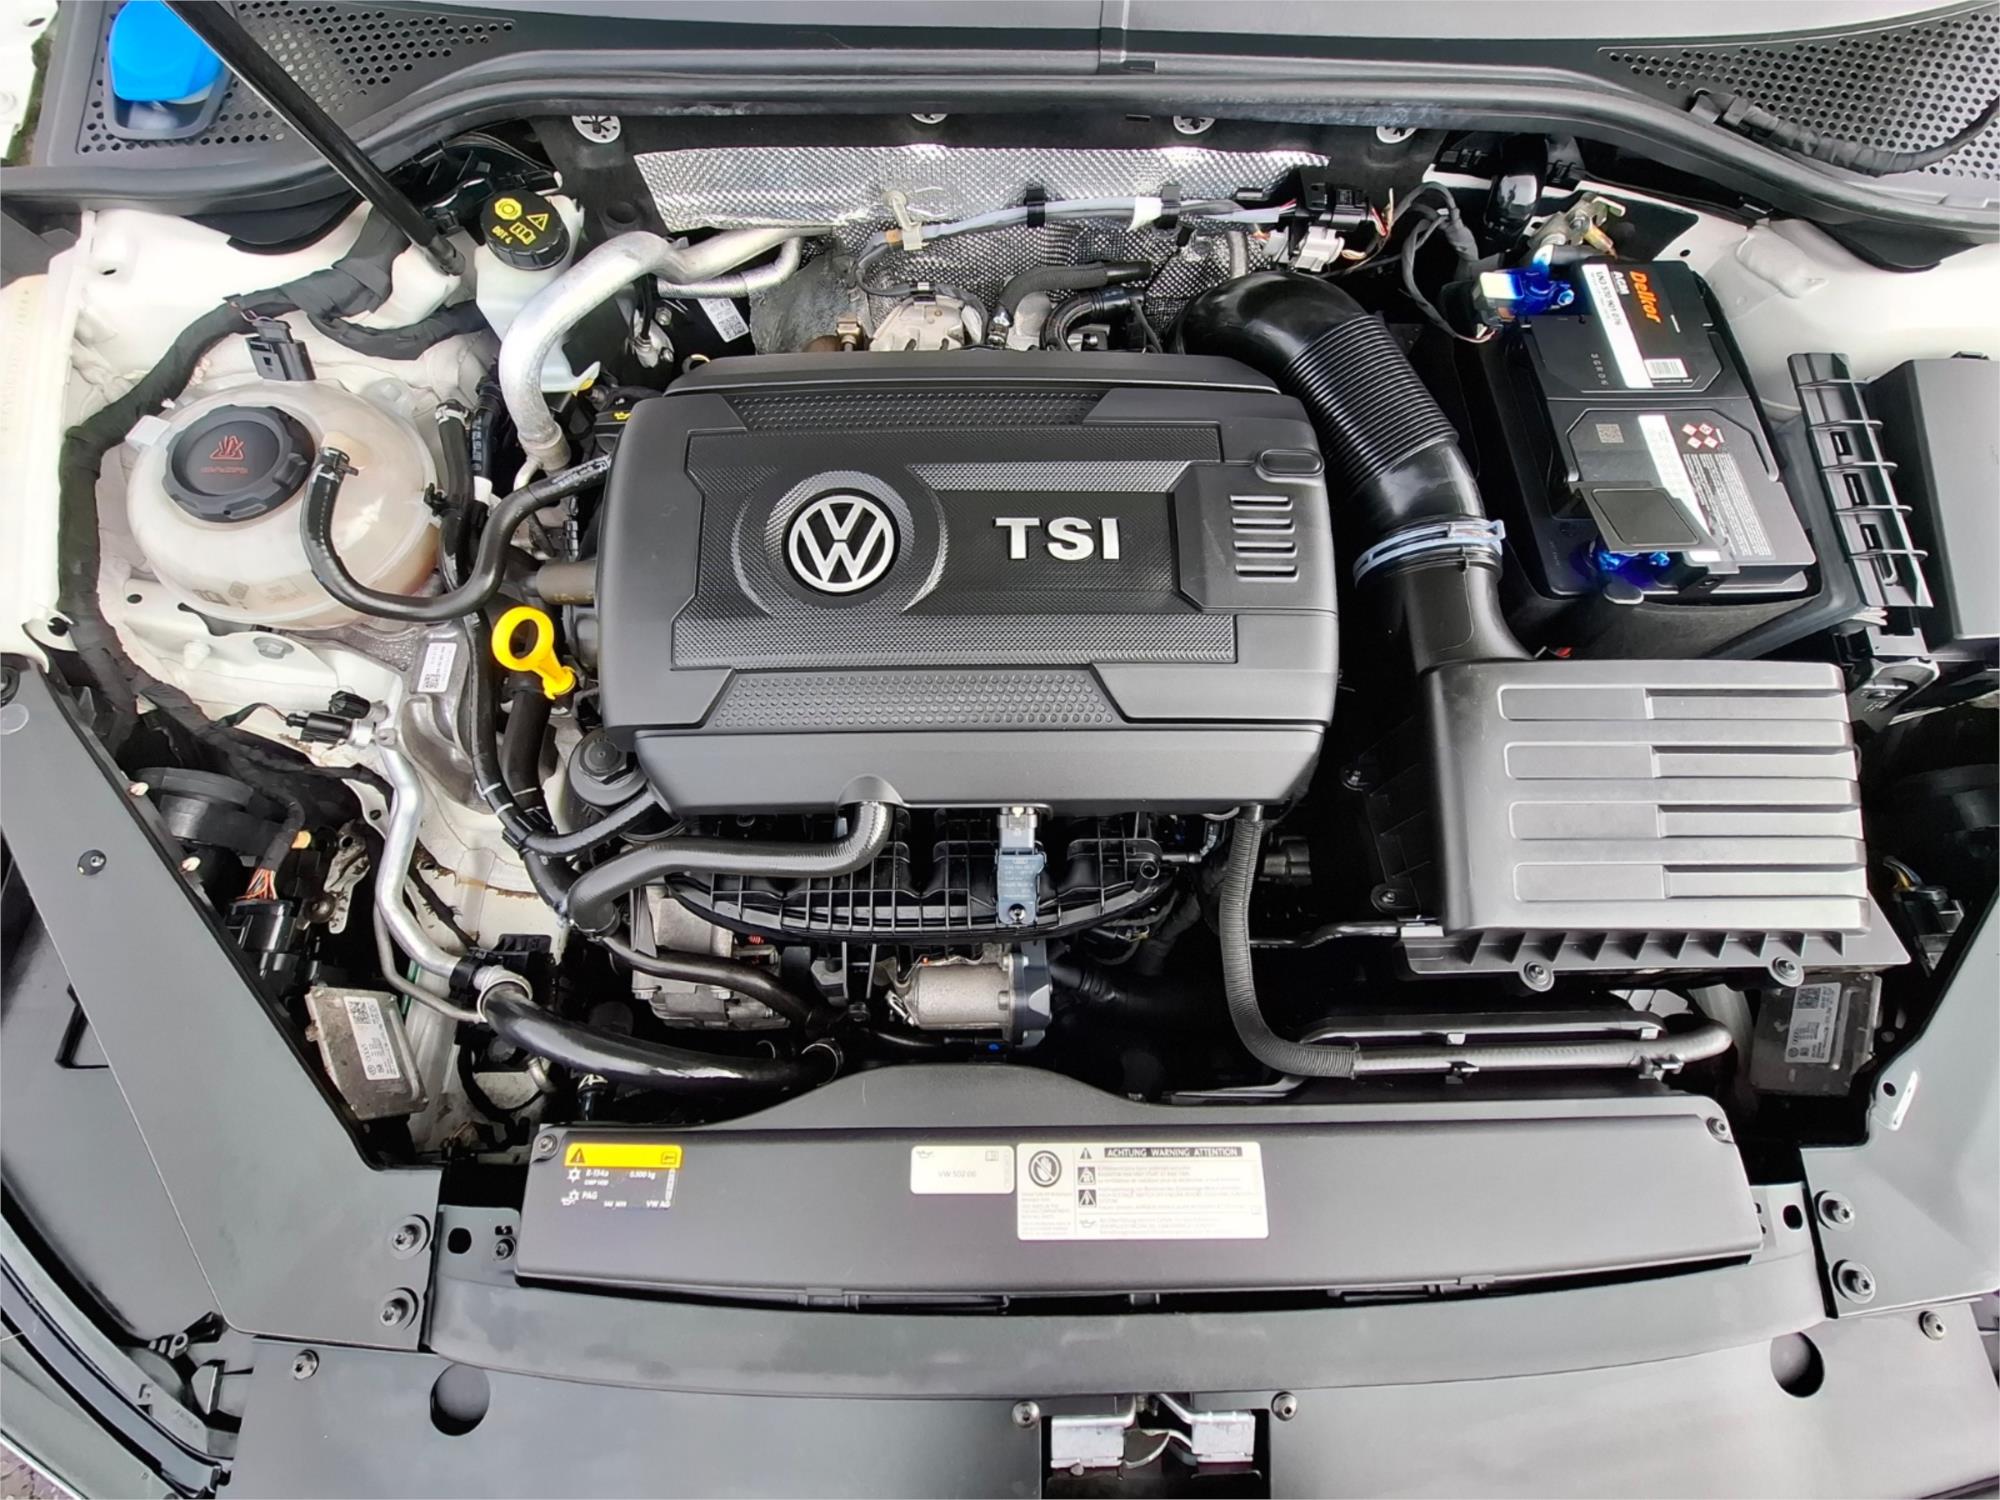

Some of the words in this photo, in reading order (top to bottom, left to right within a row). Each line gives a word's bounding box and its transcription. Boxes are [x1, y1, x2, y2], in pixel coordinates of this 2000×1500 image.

[1630, 270, 1661, 323] Delkor
[994, 516, 1121, 562] TSI
[1107, 1147, 1147, 1158] ACHTUNG
[1150, 1147, 1190, 1157] WARNING
[1193, 1146, 1238, 1157] ATTENTION
[938, 1170, 951, 1178] VW
